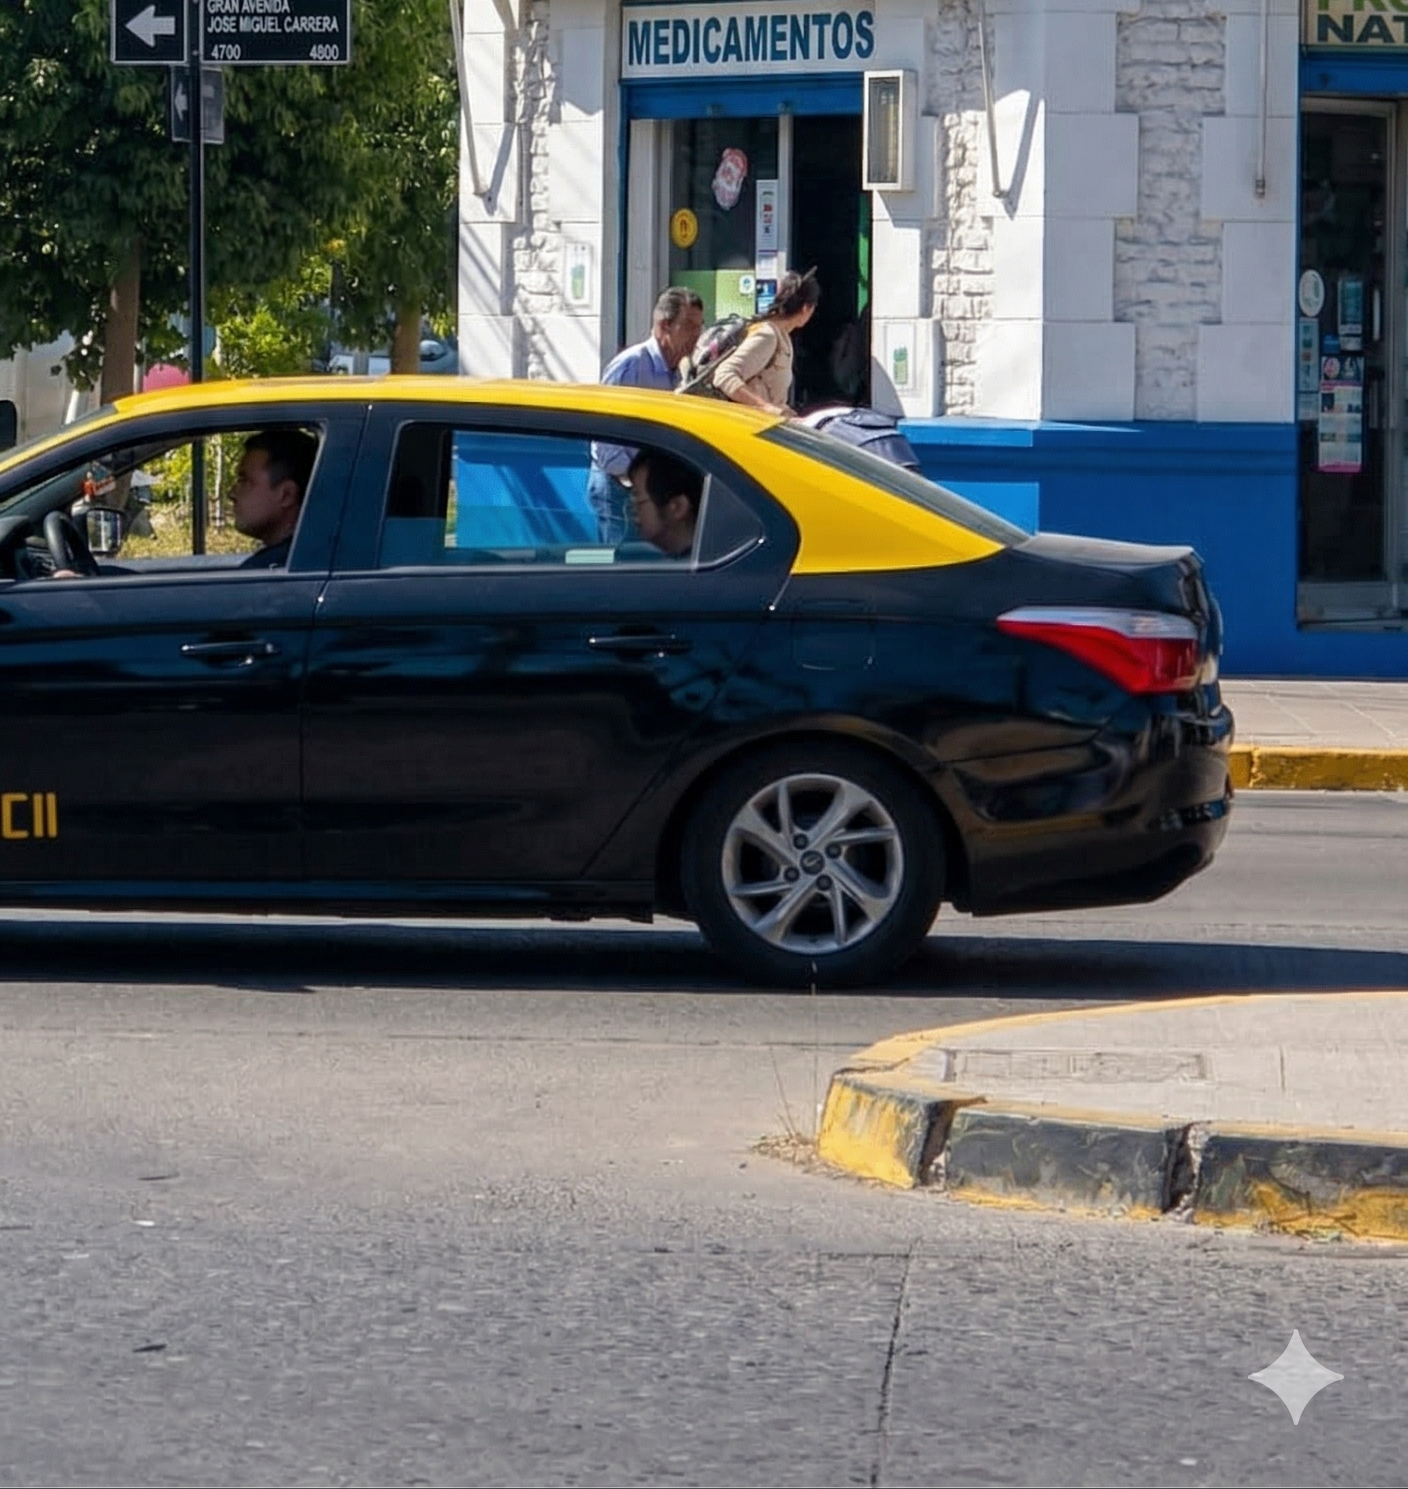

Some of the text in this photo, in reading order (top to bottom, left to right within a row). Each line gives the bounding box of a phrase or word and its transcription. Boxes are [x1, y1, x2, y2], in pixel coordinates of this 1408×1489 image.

[207, 16, 339, 33] JOSE MIGUEL CARRERA
[628, 11, 875, 65] MEDICAMENTOS
[211, 44, 339, 60] 4700 4800
